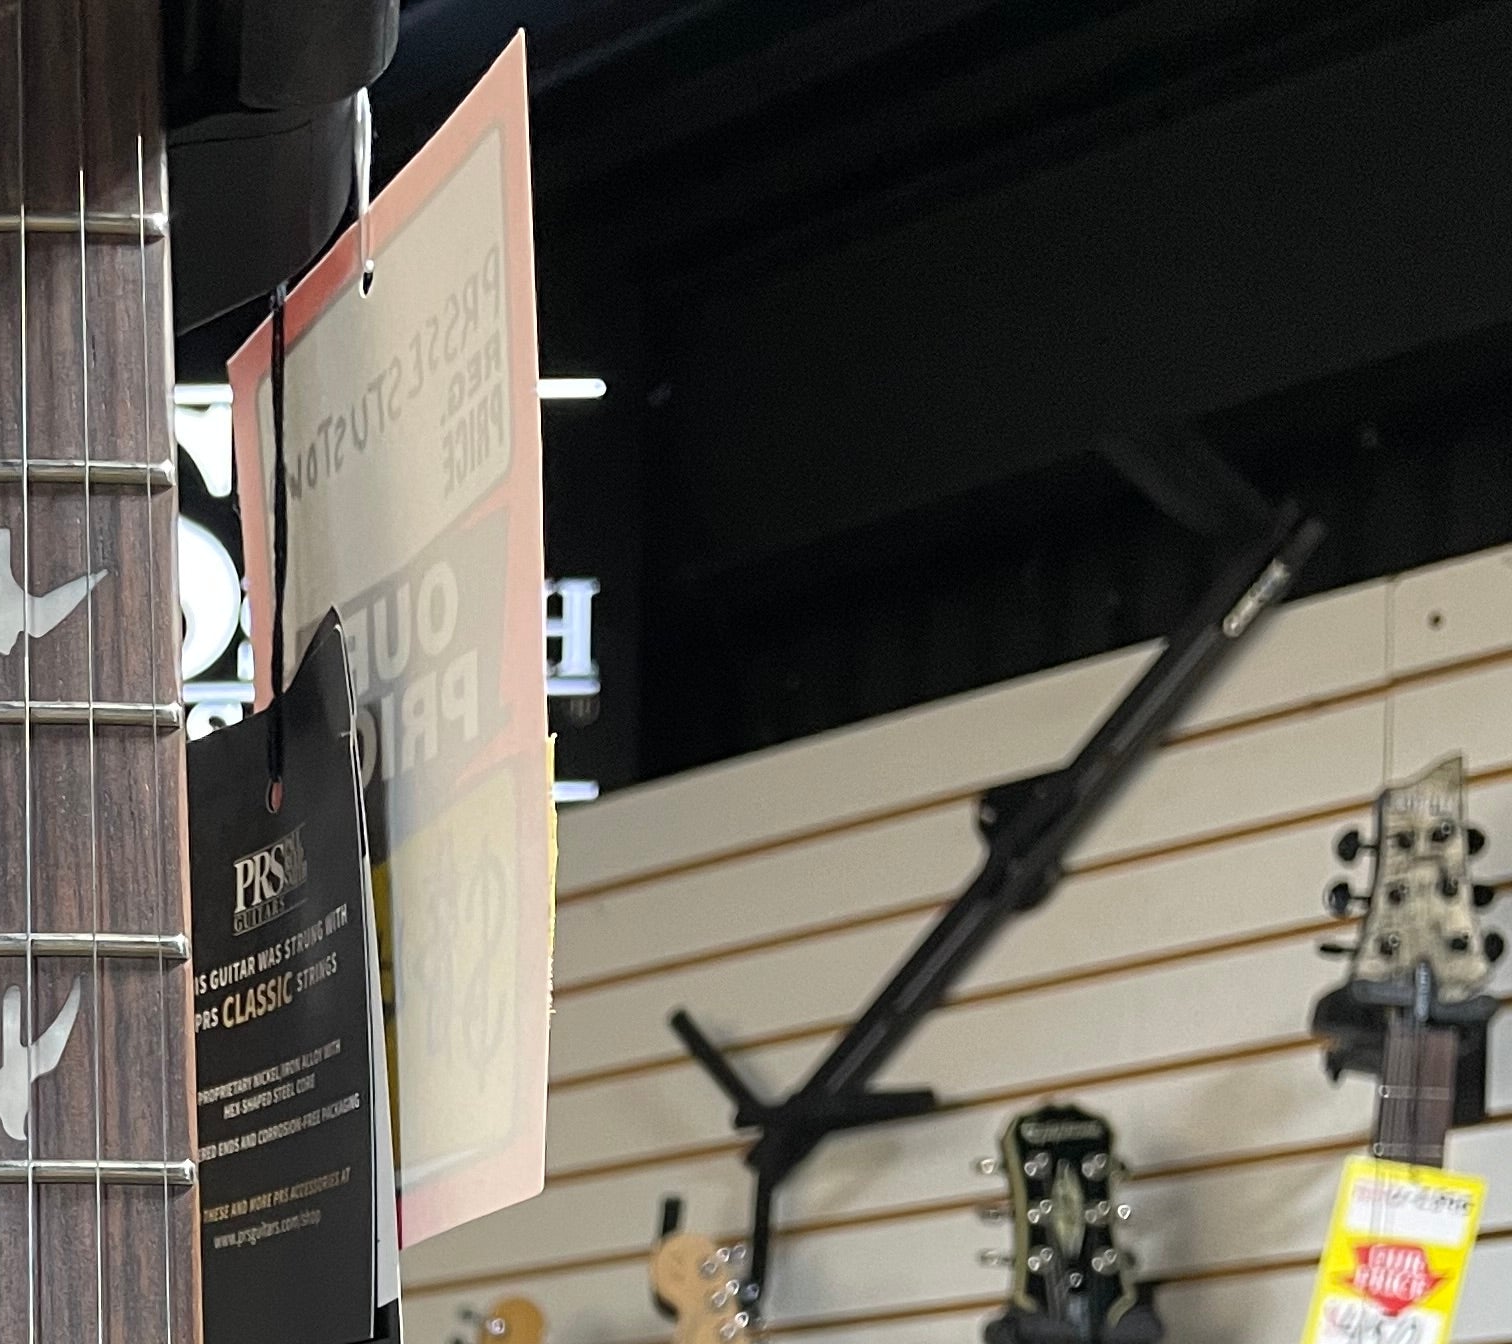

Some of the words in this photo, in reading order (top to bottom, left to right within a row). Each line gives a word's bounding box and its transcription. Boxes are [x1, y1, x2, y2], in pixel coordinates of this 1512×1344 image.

[234, 843, 289, 915] PRS
[209, 956, 256, 990] GUITAR
[257, 943, 282, 972] WAS
[284, 920, 324, 959] STRUNG
[324, 903, 349, 937] WITH
[194, 1006, 219, 1034] PRS
[221, 970, 294, 1029] CLASSIC
[296, 951, 338, 993] STRINGS
